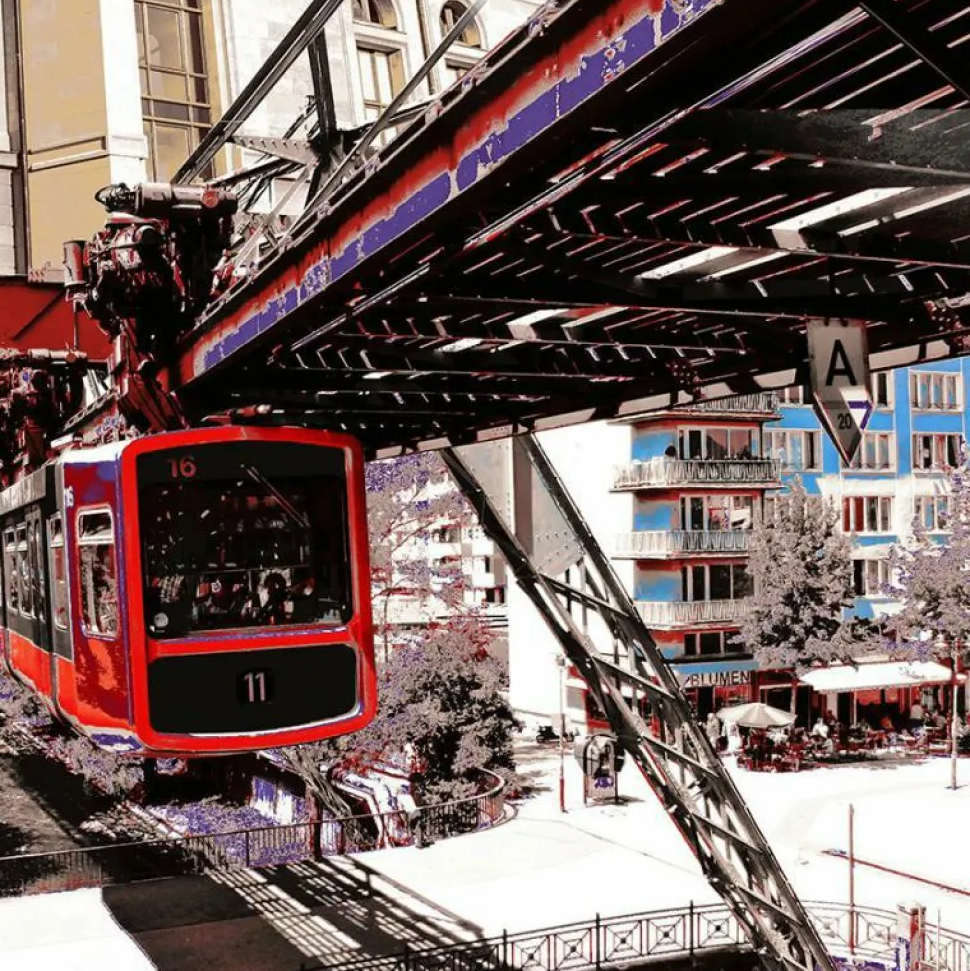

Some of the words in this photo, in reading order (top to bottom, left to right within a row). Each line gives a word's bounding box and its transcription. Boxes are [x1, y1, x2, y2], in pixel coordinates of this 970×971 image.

[825, 339, 857, 386] A
[838, 413, 852, 430] 20
[168, 456, 196, 479] 16
[243, 672, 267, 703] 11
[690, 670, 752, 686] BLUMEN
